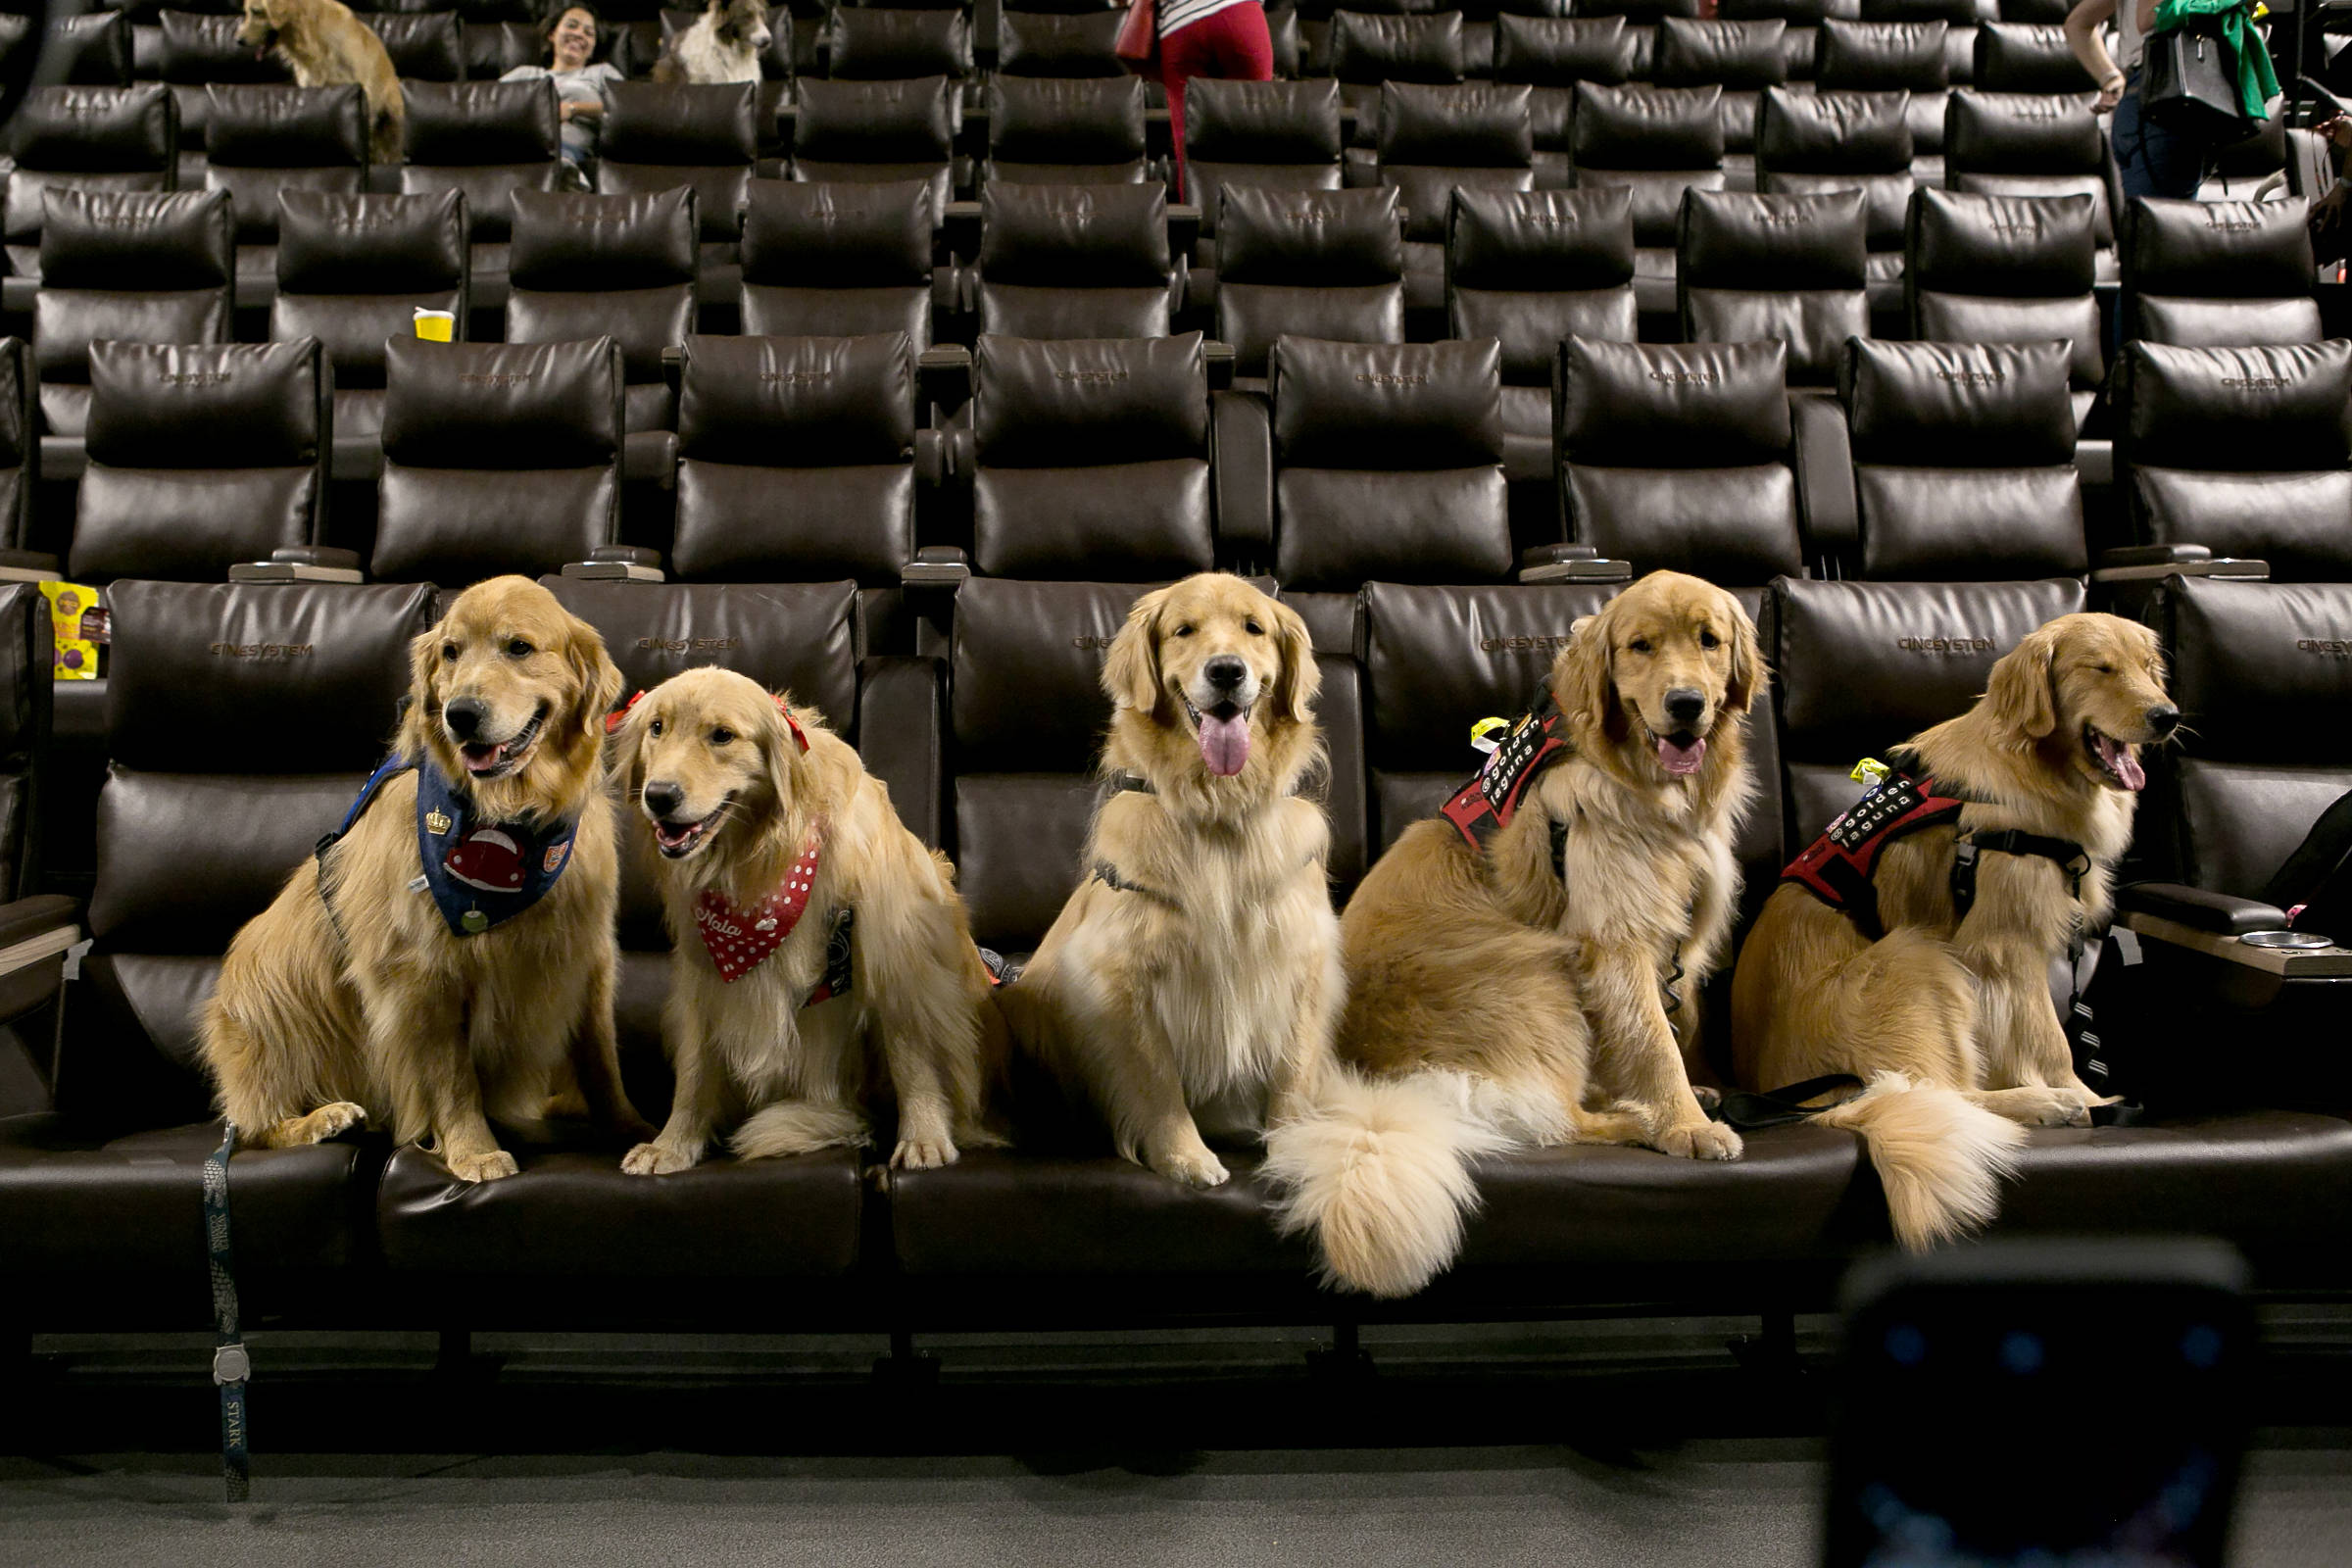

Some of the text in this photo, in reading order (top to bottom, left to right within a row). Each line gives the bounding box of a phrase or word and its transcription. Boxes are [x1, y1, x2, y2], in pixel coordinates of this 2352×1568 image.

[210, 642, 314, 658] CINESYSTEM
[1480, 635, 1571, 652] CINESYSTE
[1898, 637, 1995, 652] CINESYSTEM
[1490, 745, 1533, 807] laguna
[1840, 796, 1911, 849] laguna
[695, 907, 743, 936] Nala
[226, 1401, 242, 1448] STARK
